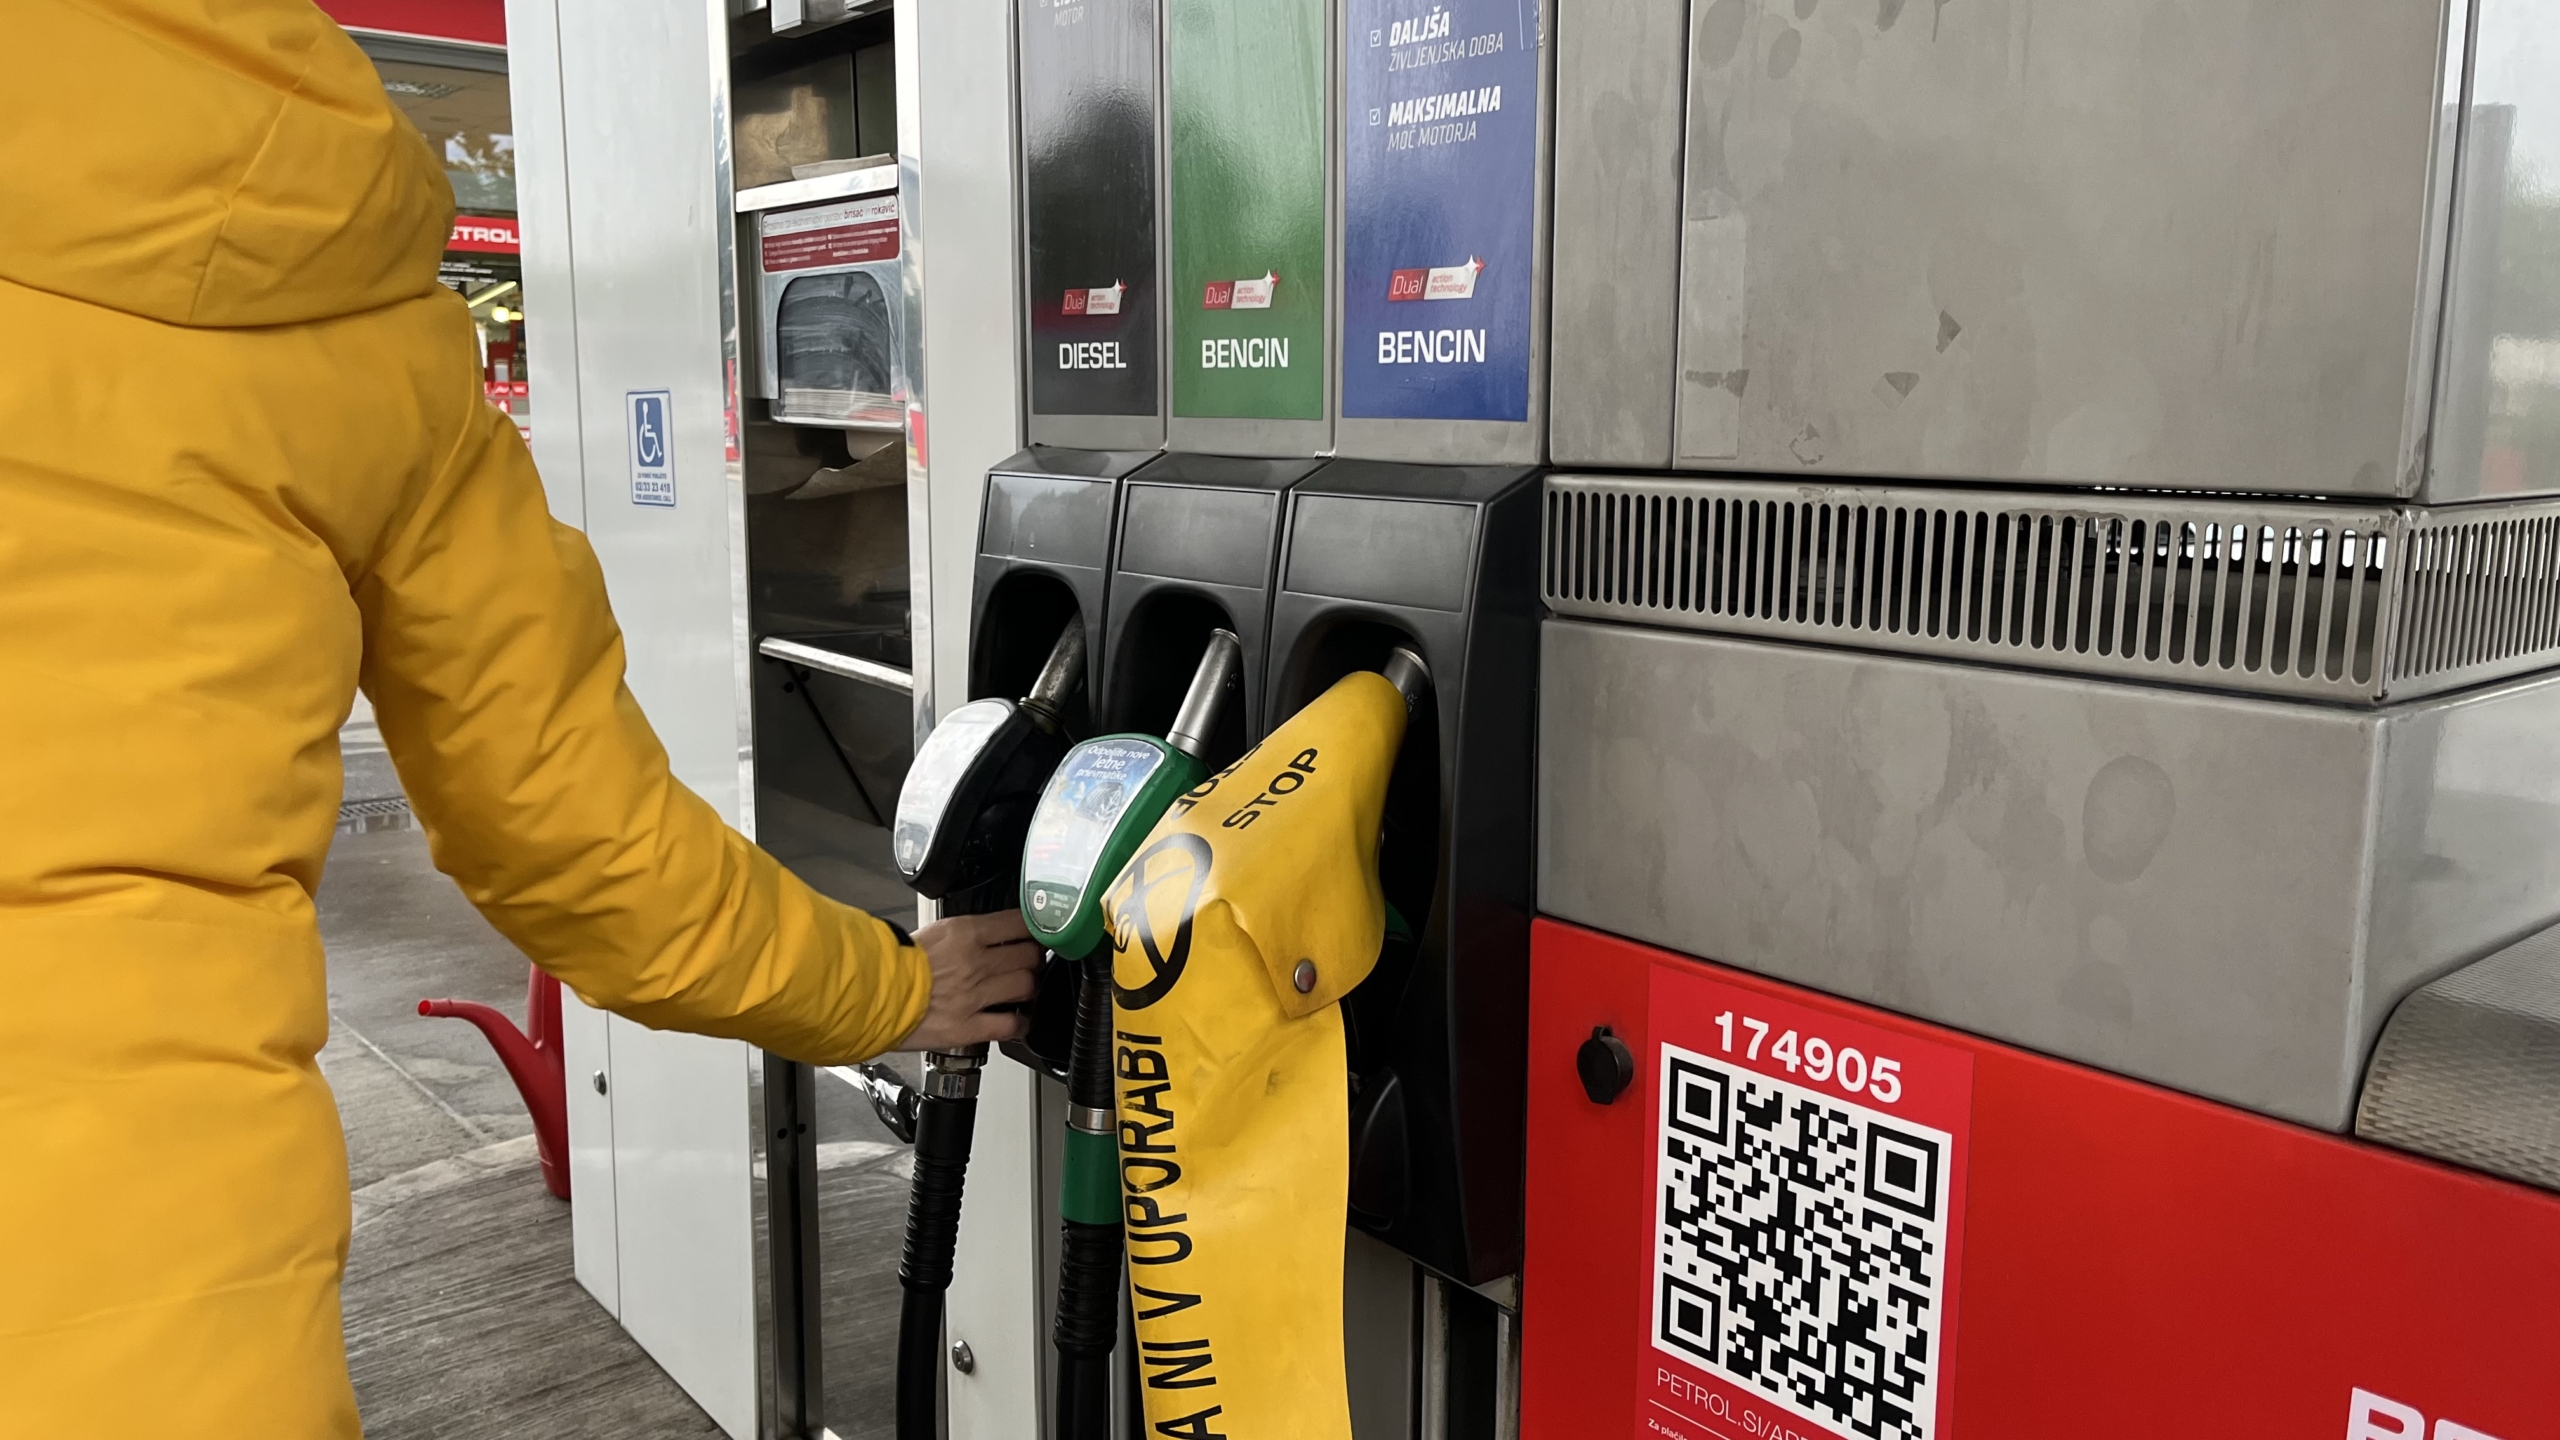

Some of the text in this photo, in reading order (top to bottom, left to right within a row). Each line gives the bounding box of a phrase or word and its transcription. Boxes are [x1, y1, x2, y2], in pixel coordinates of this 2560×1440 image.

[1054, 6, 1084, 27] MOTOR
[1389, 5, 1450, 47] DALJŠA
[1388, 32, 1503, 72] ŽIVLJENJSKA DOBA
[1387, 85, 1501, 127] MAKSIMALNA
[1387, 120, 1476, 151] MOČ MOTORJA
[450, 226, 519, 244] TROL
[1237, 286, 1254, 294] action
[1392, 275, 1424, 295] Dual
[1430, 283, 1468, 294] technology
[1431, 274, 1453, 283] action
[1064, 294, 1085, 310] Dual
[1205, 286, 1230, 304] Dual
[1236, 294, 1266, 304] technology
[1059, 341, 1127, 369] DIESEL
[1202, 337, 1289, 368] BENCIN
[1378, 329, 1486, 364] BENCIN
[1092, 755, 1126, 770] letne
[1126, 750, 1150, 759] nove
[1074, 768, 1127, 780] pnevmatike
[1222, 748, 1318, 829] STOP
[1715, 1010, 1901, 1103] 174905
[1116, 1030, 1193, 1266] UPORABI
[1133, 1282, 1202, 1321] V
[1141, 1338, 1217, 1391] NI
[1657, 1367, 1809, 1440] PETROL.SI/AP
[1648, 1418, 1660, 1431] Za
